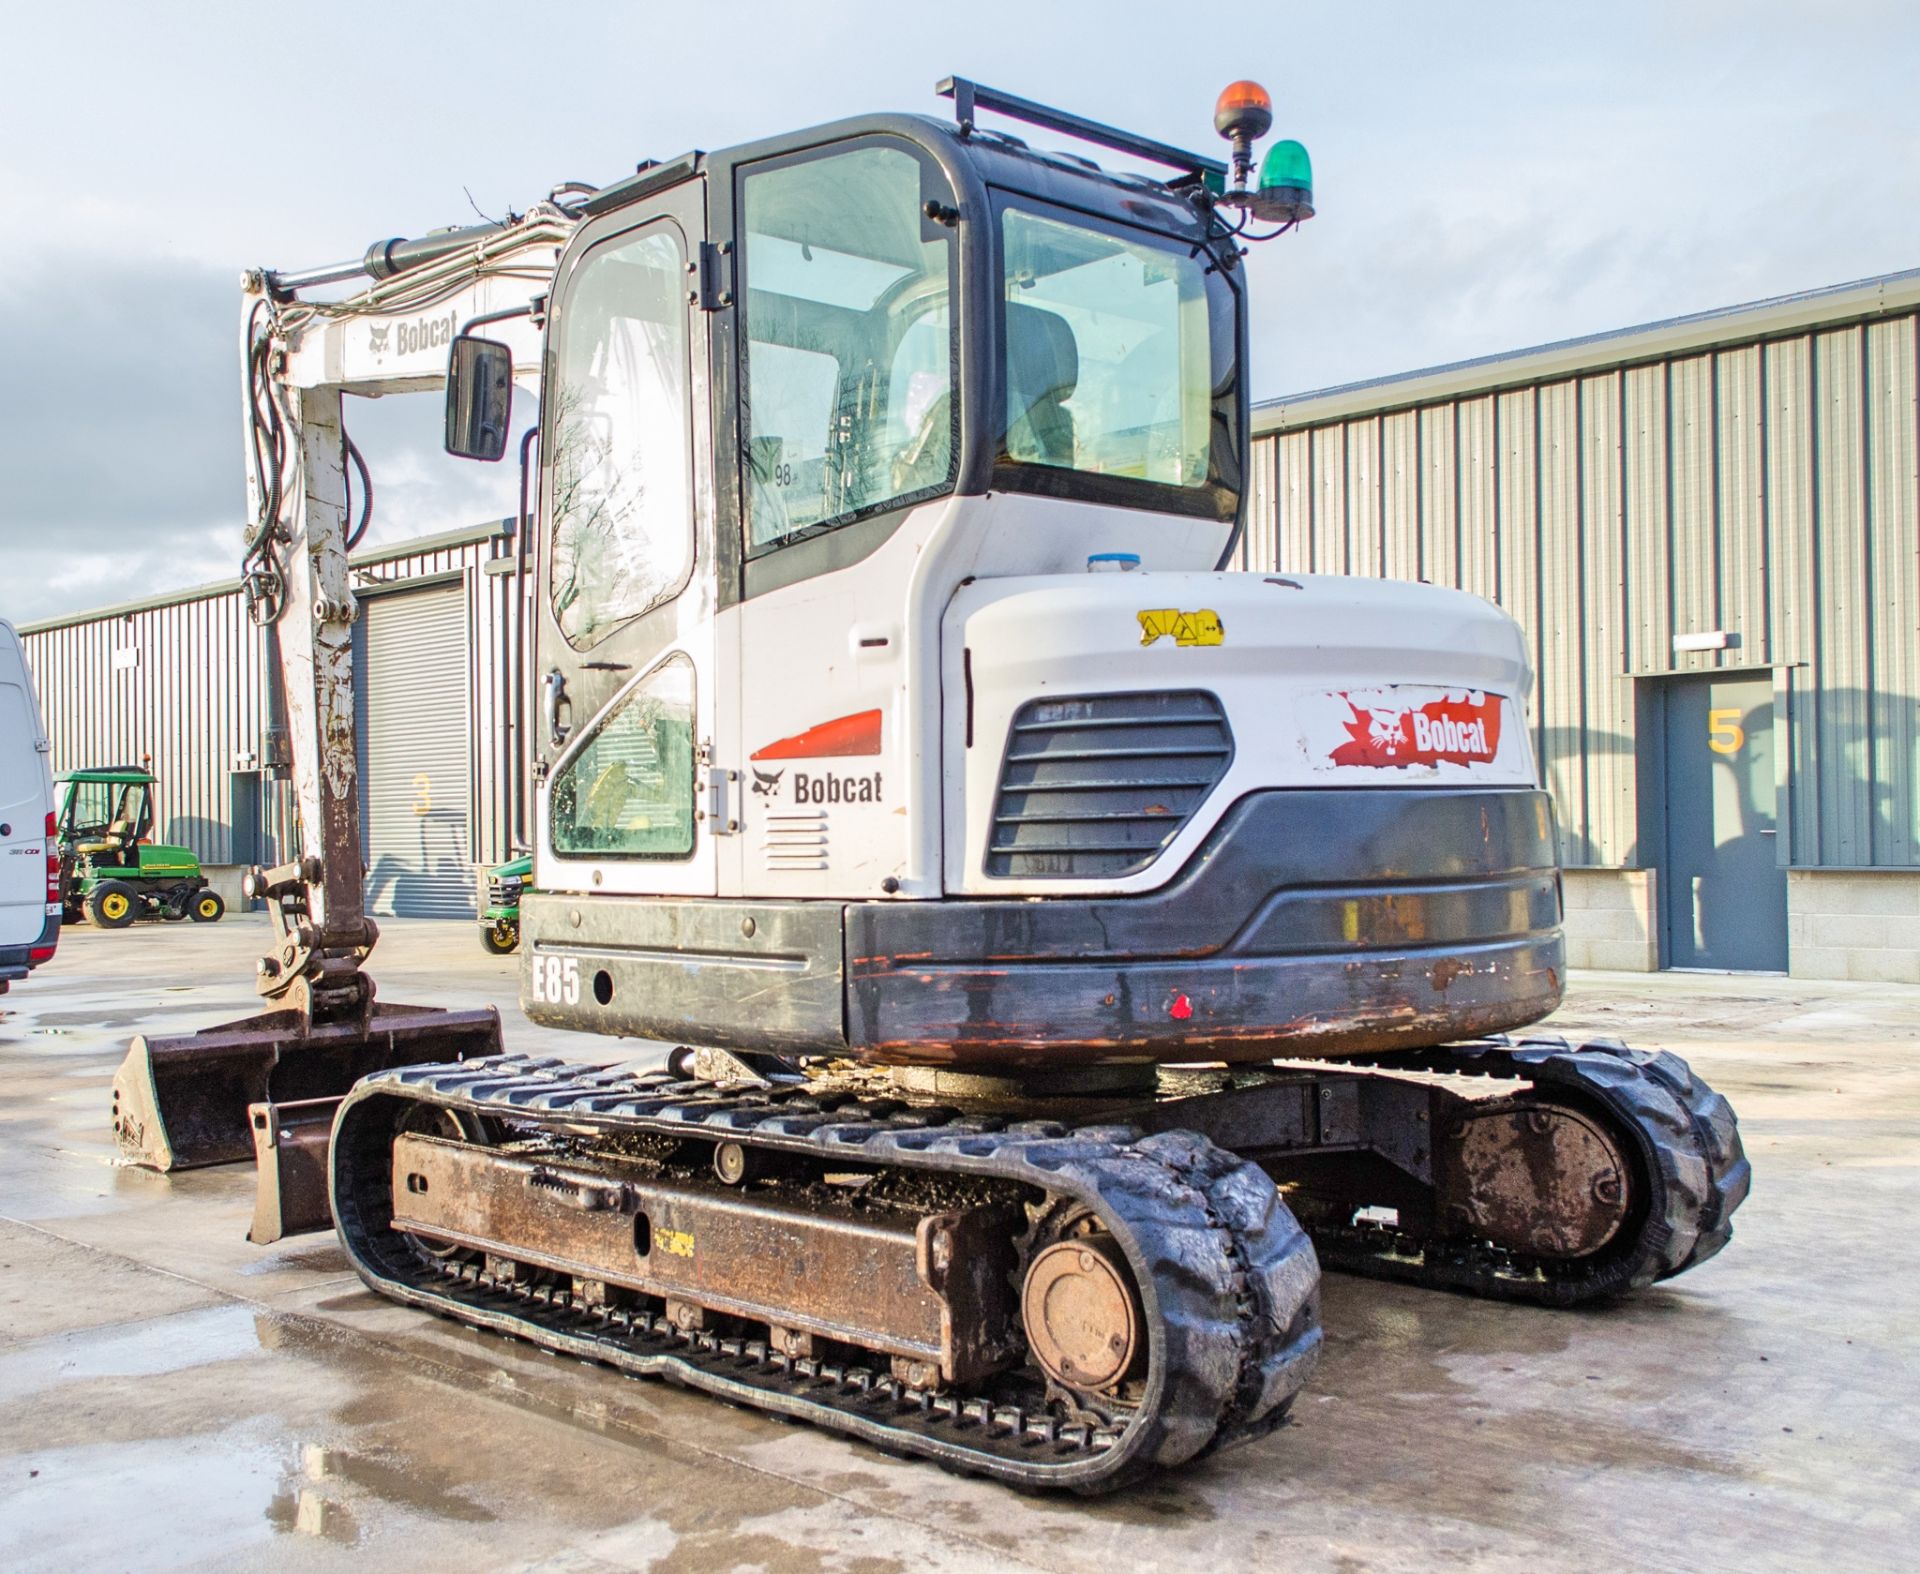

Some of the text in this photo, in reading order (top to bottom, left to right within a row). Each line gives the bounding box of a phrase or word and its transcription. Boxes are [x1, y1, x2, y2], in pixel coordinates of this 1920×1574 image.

[397, 309, 457, 357] Bobcat
[775, 463, 791, 487] 98
[1412, 711, 1489, 754] Bobcat
[1708, 708, 1745, 754] 5
[411, 771, 433, 817] 3
[794, 771, 883, 804] Bobcat
[532, 955, 580, 1006] E85
